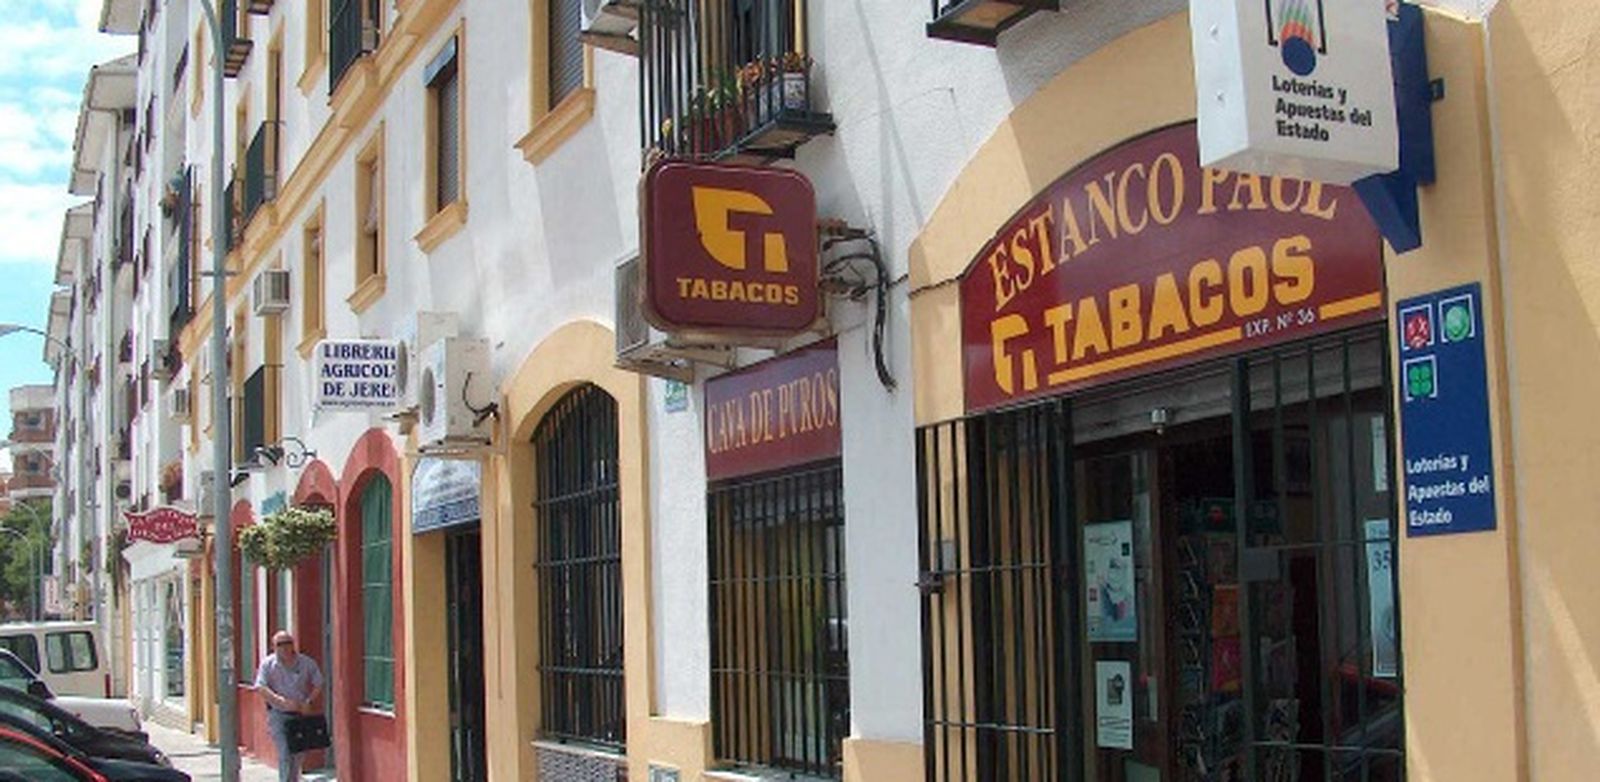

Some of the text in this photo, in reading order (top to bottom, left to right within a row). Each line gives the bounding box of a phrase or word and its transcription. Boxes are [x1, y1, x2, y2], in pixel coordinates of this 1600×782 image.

[1338, 88, 1347, 105] y
[1275, 97, 1372, 126] Apuestas del
[1276, 120, 1330, 141] Estado
[988, 152, 1185, 312] ESTANCO
[676, 277, 800, 305] TABACOS
[1044, 233, 1316, 365] TABACOS
[1297, 307, 1315, 326] 36
[323, 382, 396, 398] DE JERE
[707, 399, 747, 454] CAVA
[750, 388, 773, 444] DE
[1459, 455, 1470, 472] y
[1408, 475, 1491, 504] Apuestas del
[1410, 507, 1453, 527] Estado
